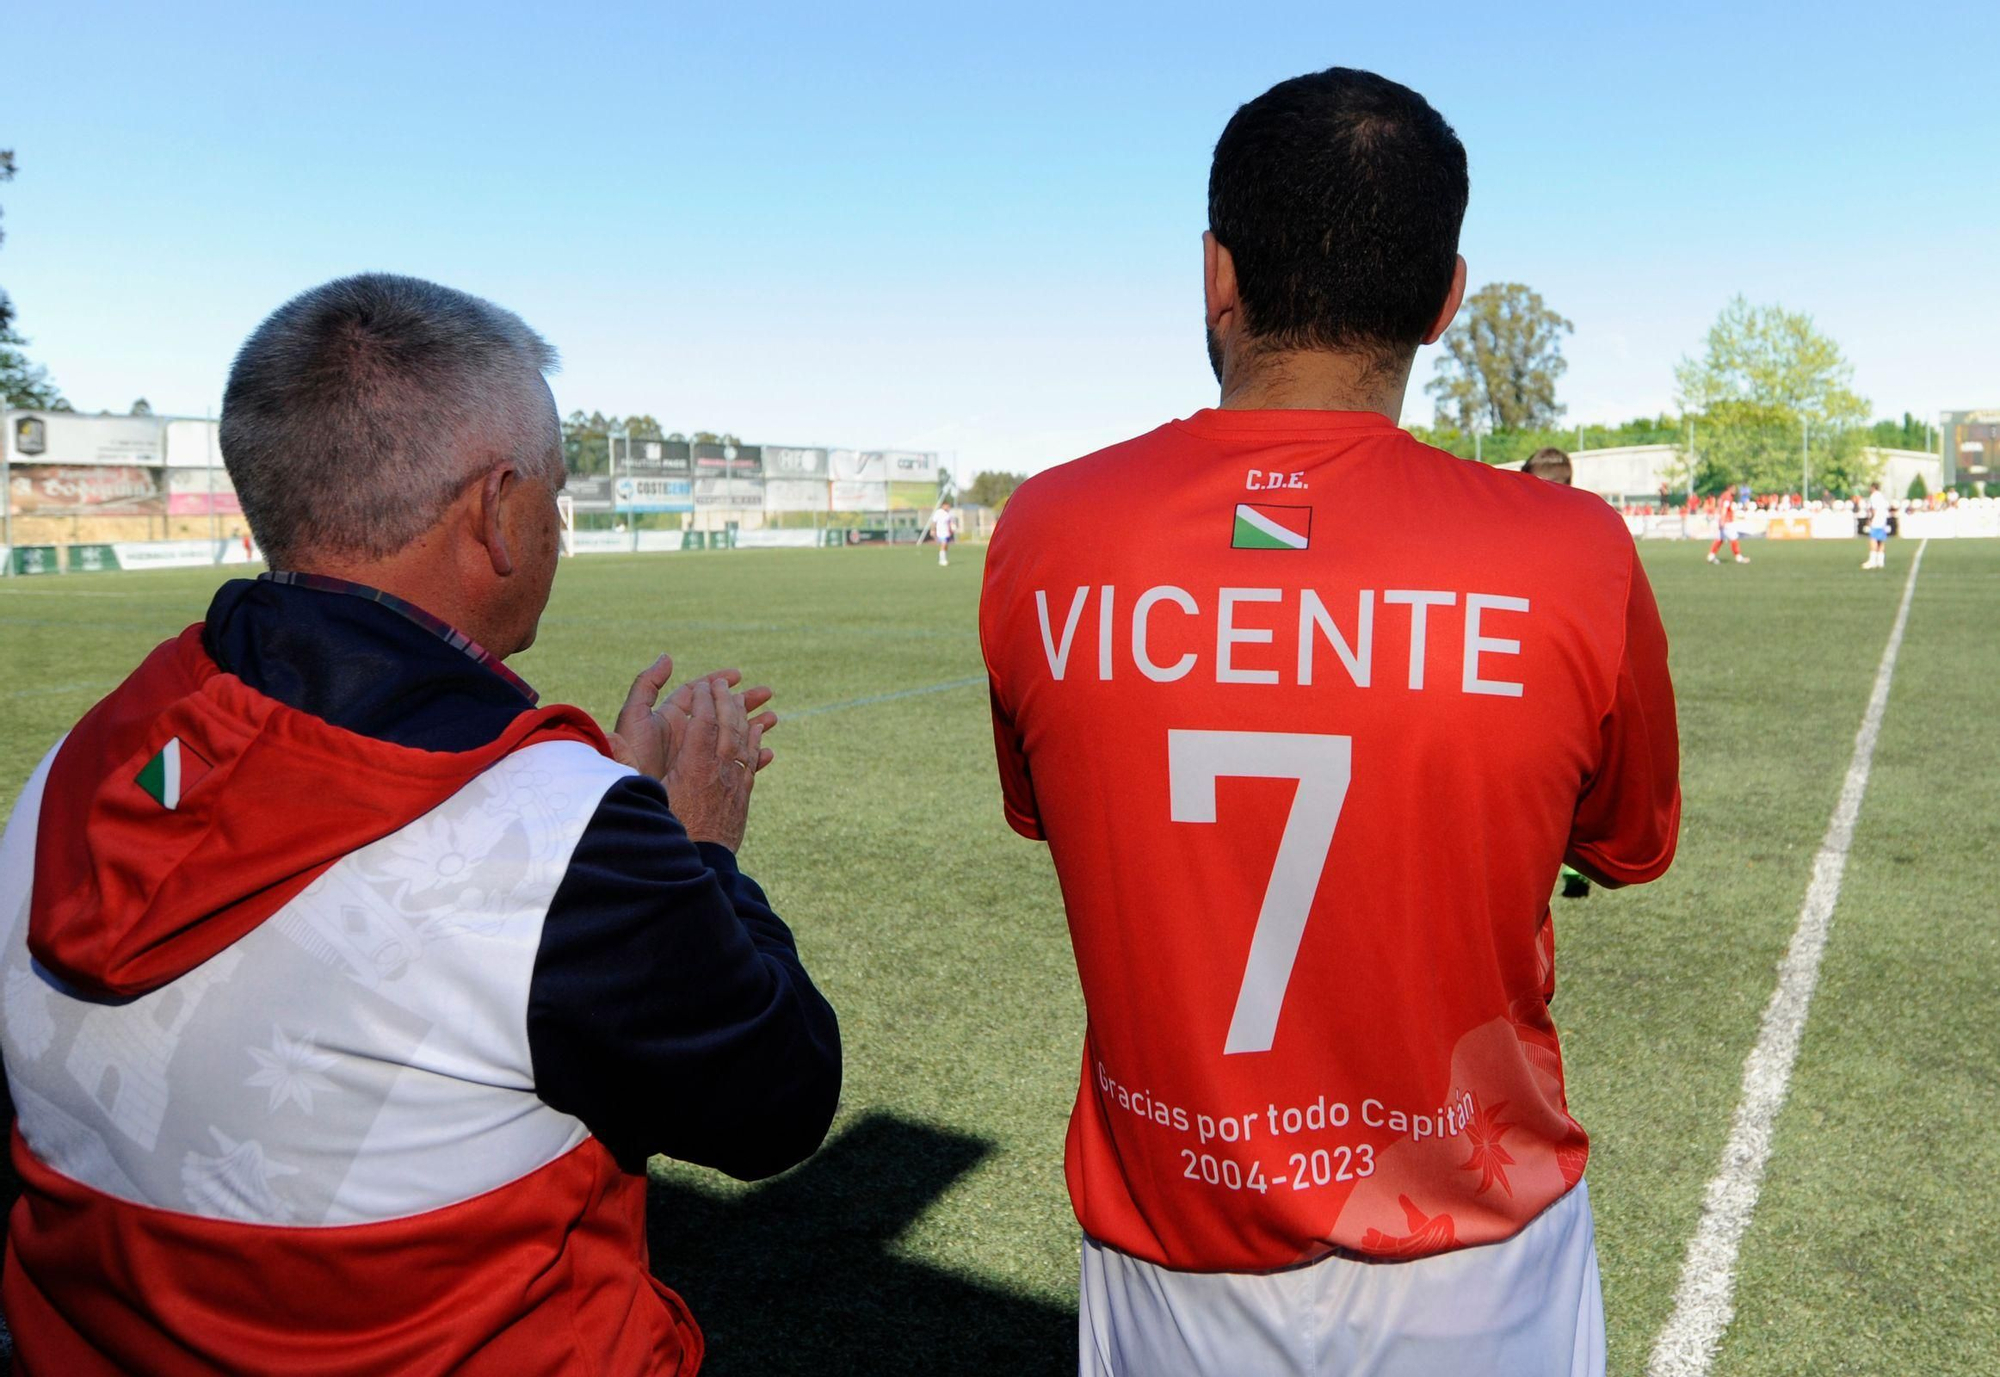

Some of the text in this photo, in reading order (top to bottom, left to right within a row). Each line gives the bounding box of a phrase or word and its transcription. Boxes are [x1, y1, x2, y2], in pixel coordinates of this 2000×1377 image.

[1245, 469, 1309, 490] C.D.E.
[1035, 585, 1530, 698] VICENTE
[1168, 729, 1352, 1055] 7
[1098, 1061, 1474, 1144] Gracias por todo Capitán
[1181, 1144, 1375, 1194] 2004-2023
